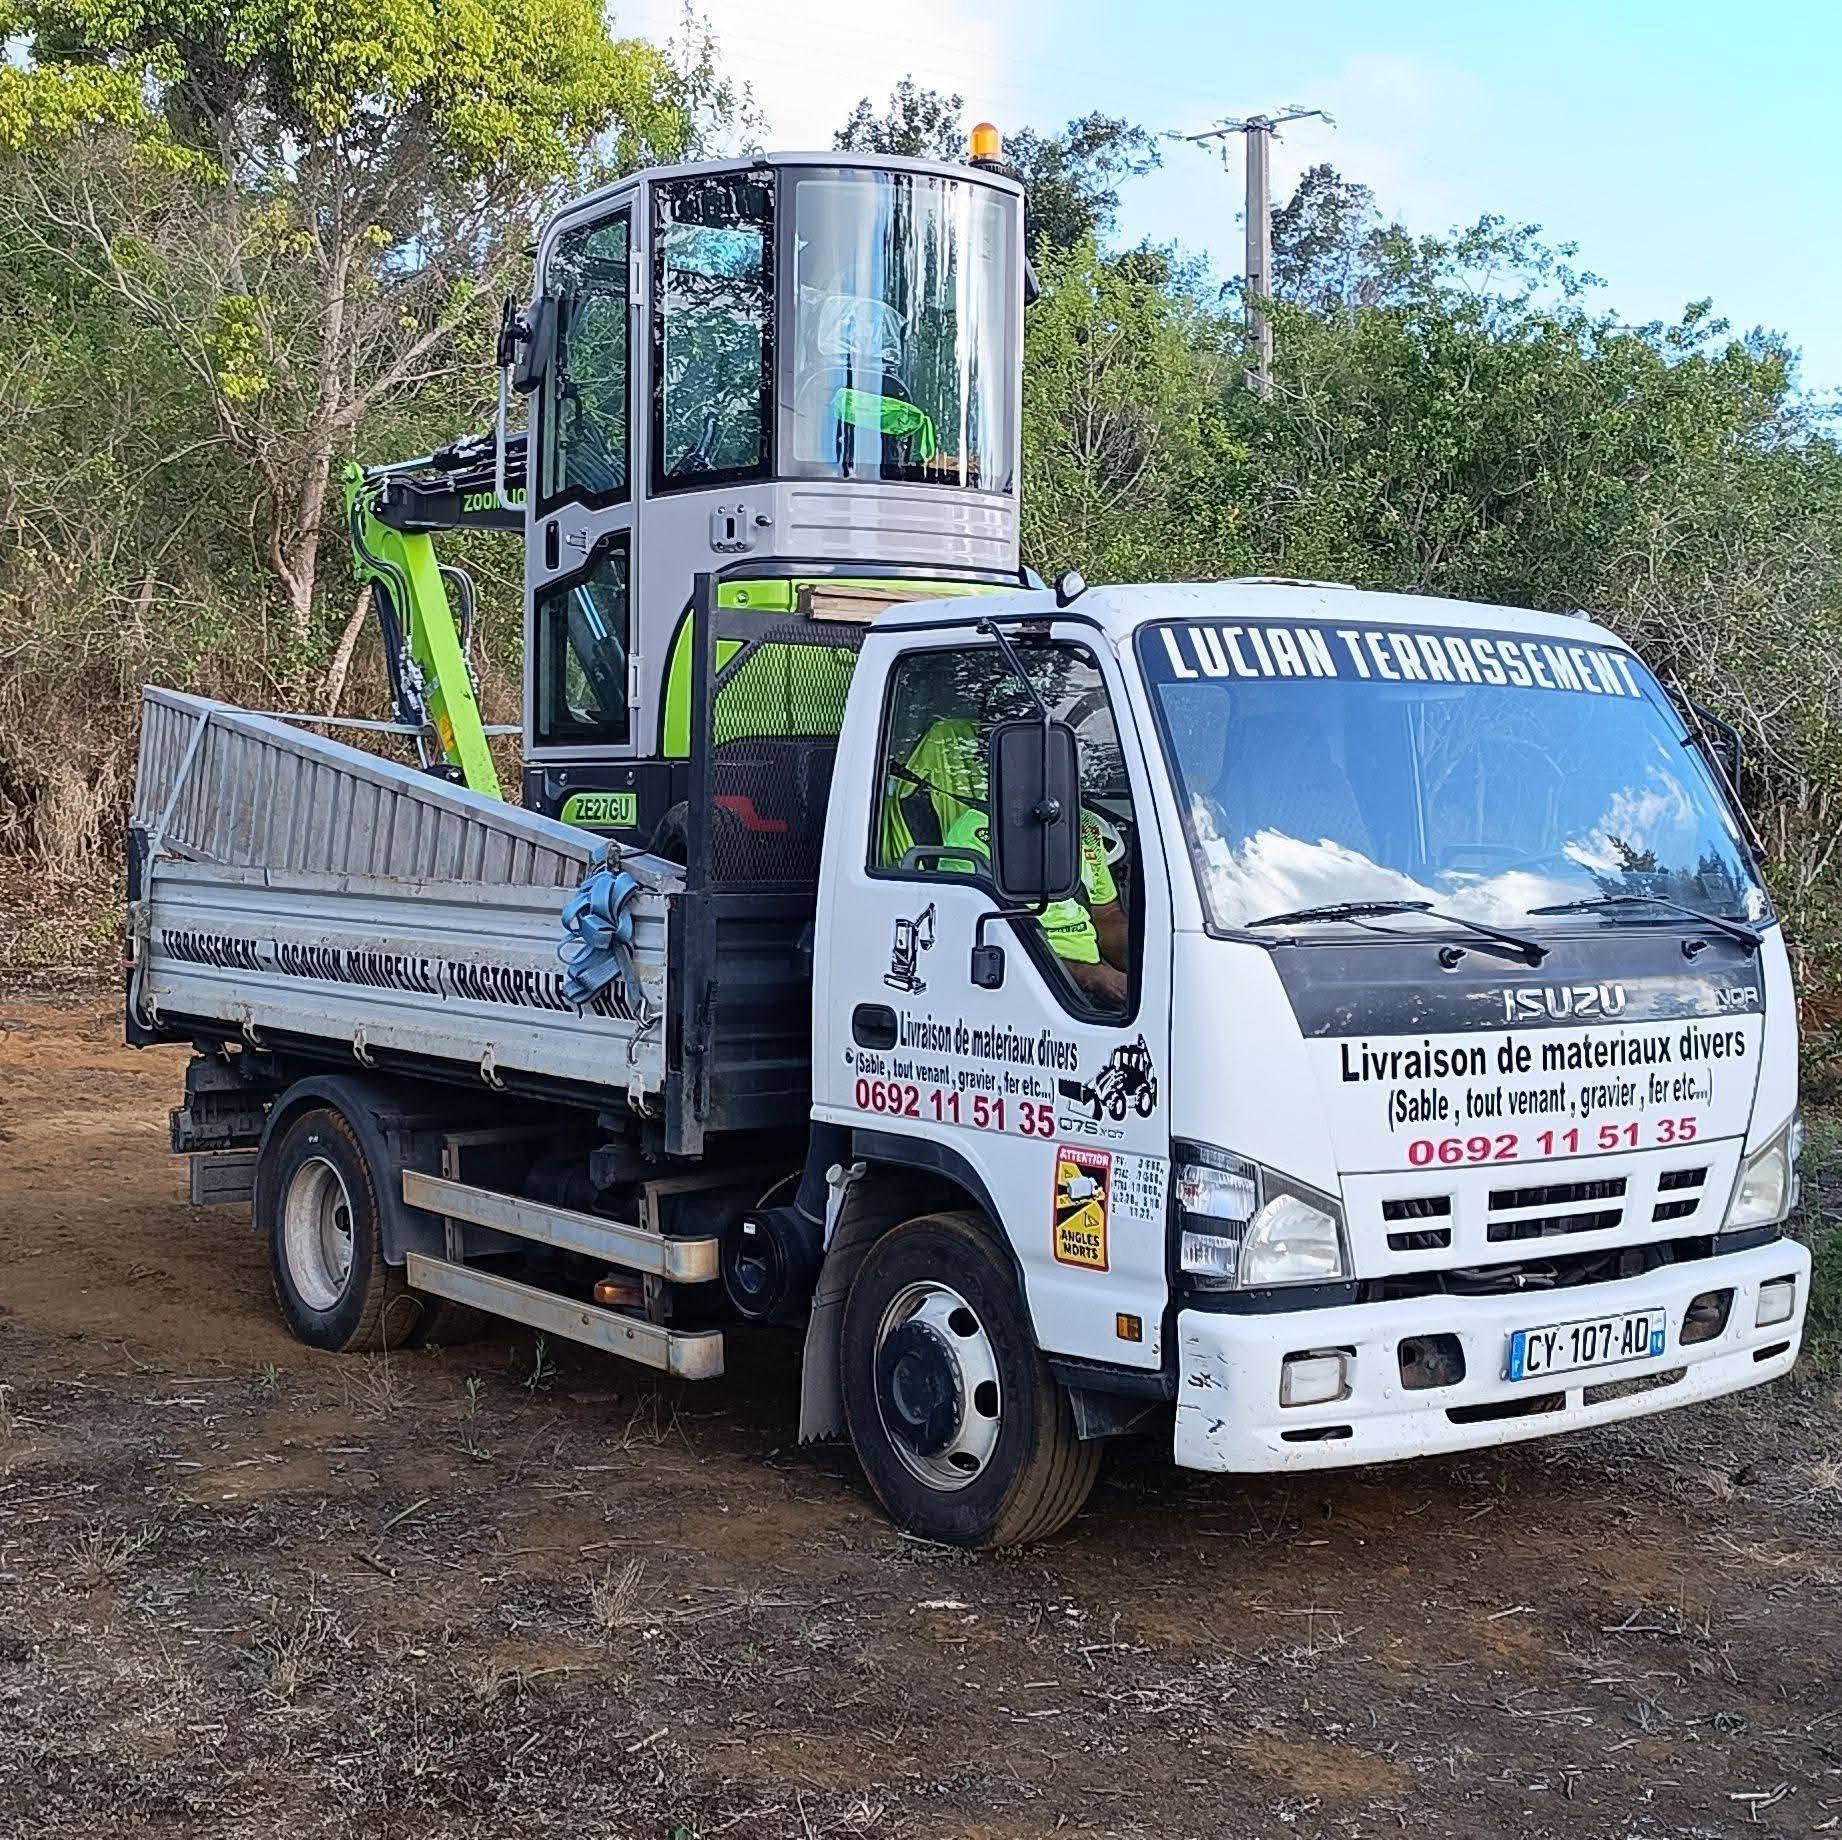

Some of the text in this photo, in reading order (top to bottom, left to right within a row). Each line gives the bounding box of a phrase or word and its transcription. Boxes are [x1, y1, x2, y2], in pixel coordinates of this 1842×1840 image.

[1160, 627, 1642, 698] LUCIAN TERRASSEMENT
[576, 798, 630, 820] ZE27GU
[162, 930, 264, 972] TERRASSEMENT
[274, 941, 350, 983] LOCATION
[347, 951, 438, 994] MINIPELLE
[448, 962, 574, 1012] TRACTOPELLE
[1503, 985, 1625, 1020] ISUZU
[900, 1011, 1078, 1071] Livraison de materiaux divers
[1341, 1025, 1745, 1082] Livraison de materiaux divers
[893, 1058, 913, 1081] tout
[916, 1064, 950, 1085] venant
[958, 1069, 996, 1092] gravier
[1466, 1086, 1502, 1118] tout
[1508, 1081, 1566, 1115] venant
[1581, 1076, 1637, 1118] gravier
[1649, 1072, 1670, 1104] fer
[855, 1078, 1056, 1138] 0692 11 51 35
[1060, 1148, 1109, 1167] ATTENTION
[1408, 1117, 1697, 1166] 0692 11 51 35
[1061, 1229, 1100, 1247] ANGLES
[1064, 1242, 1099, 1260] MORTS
